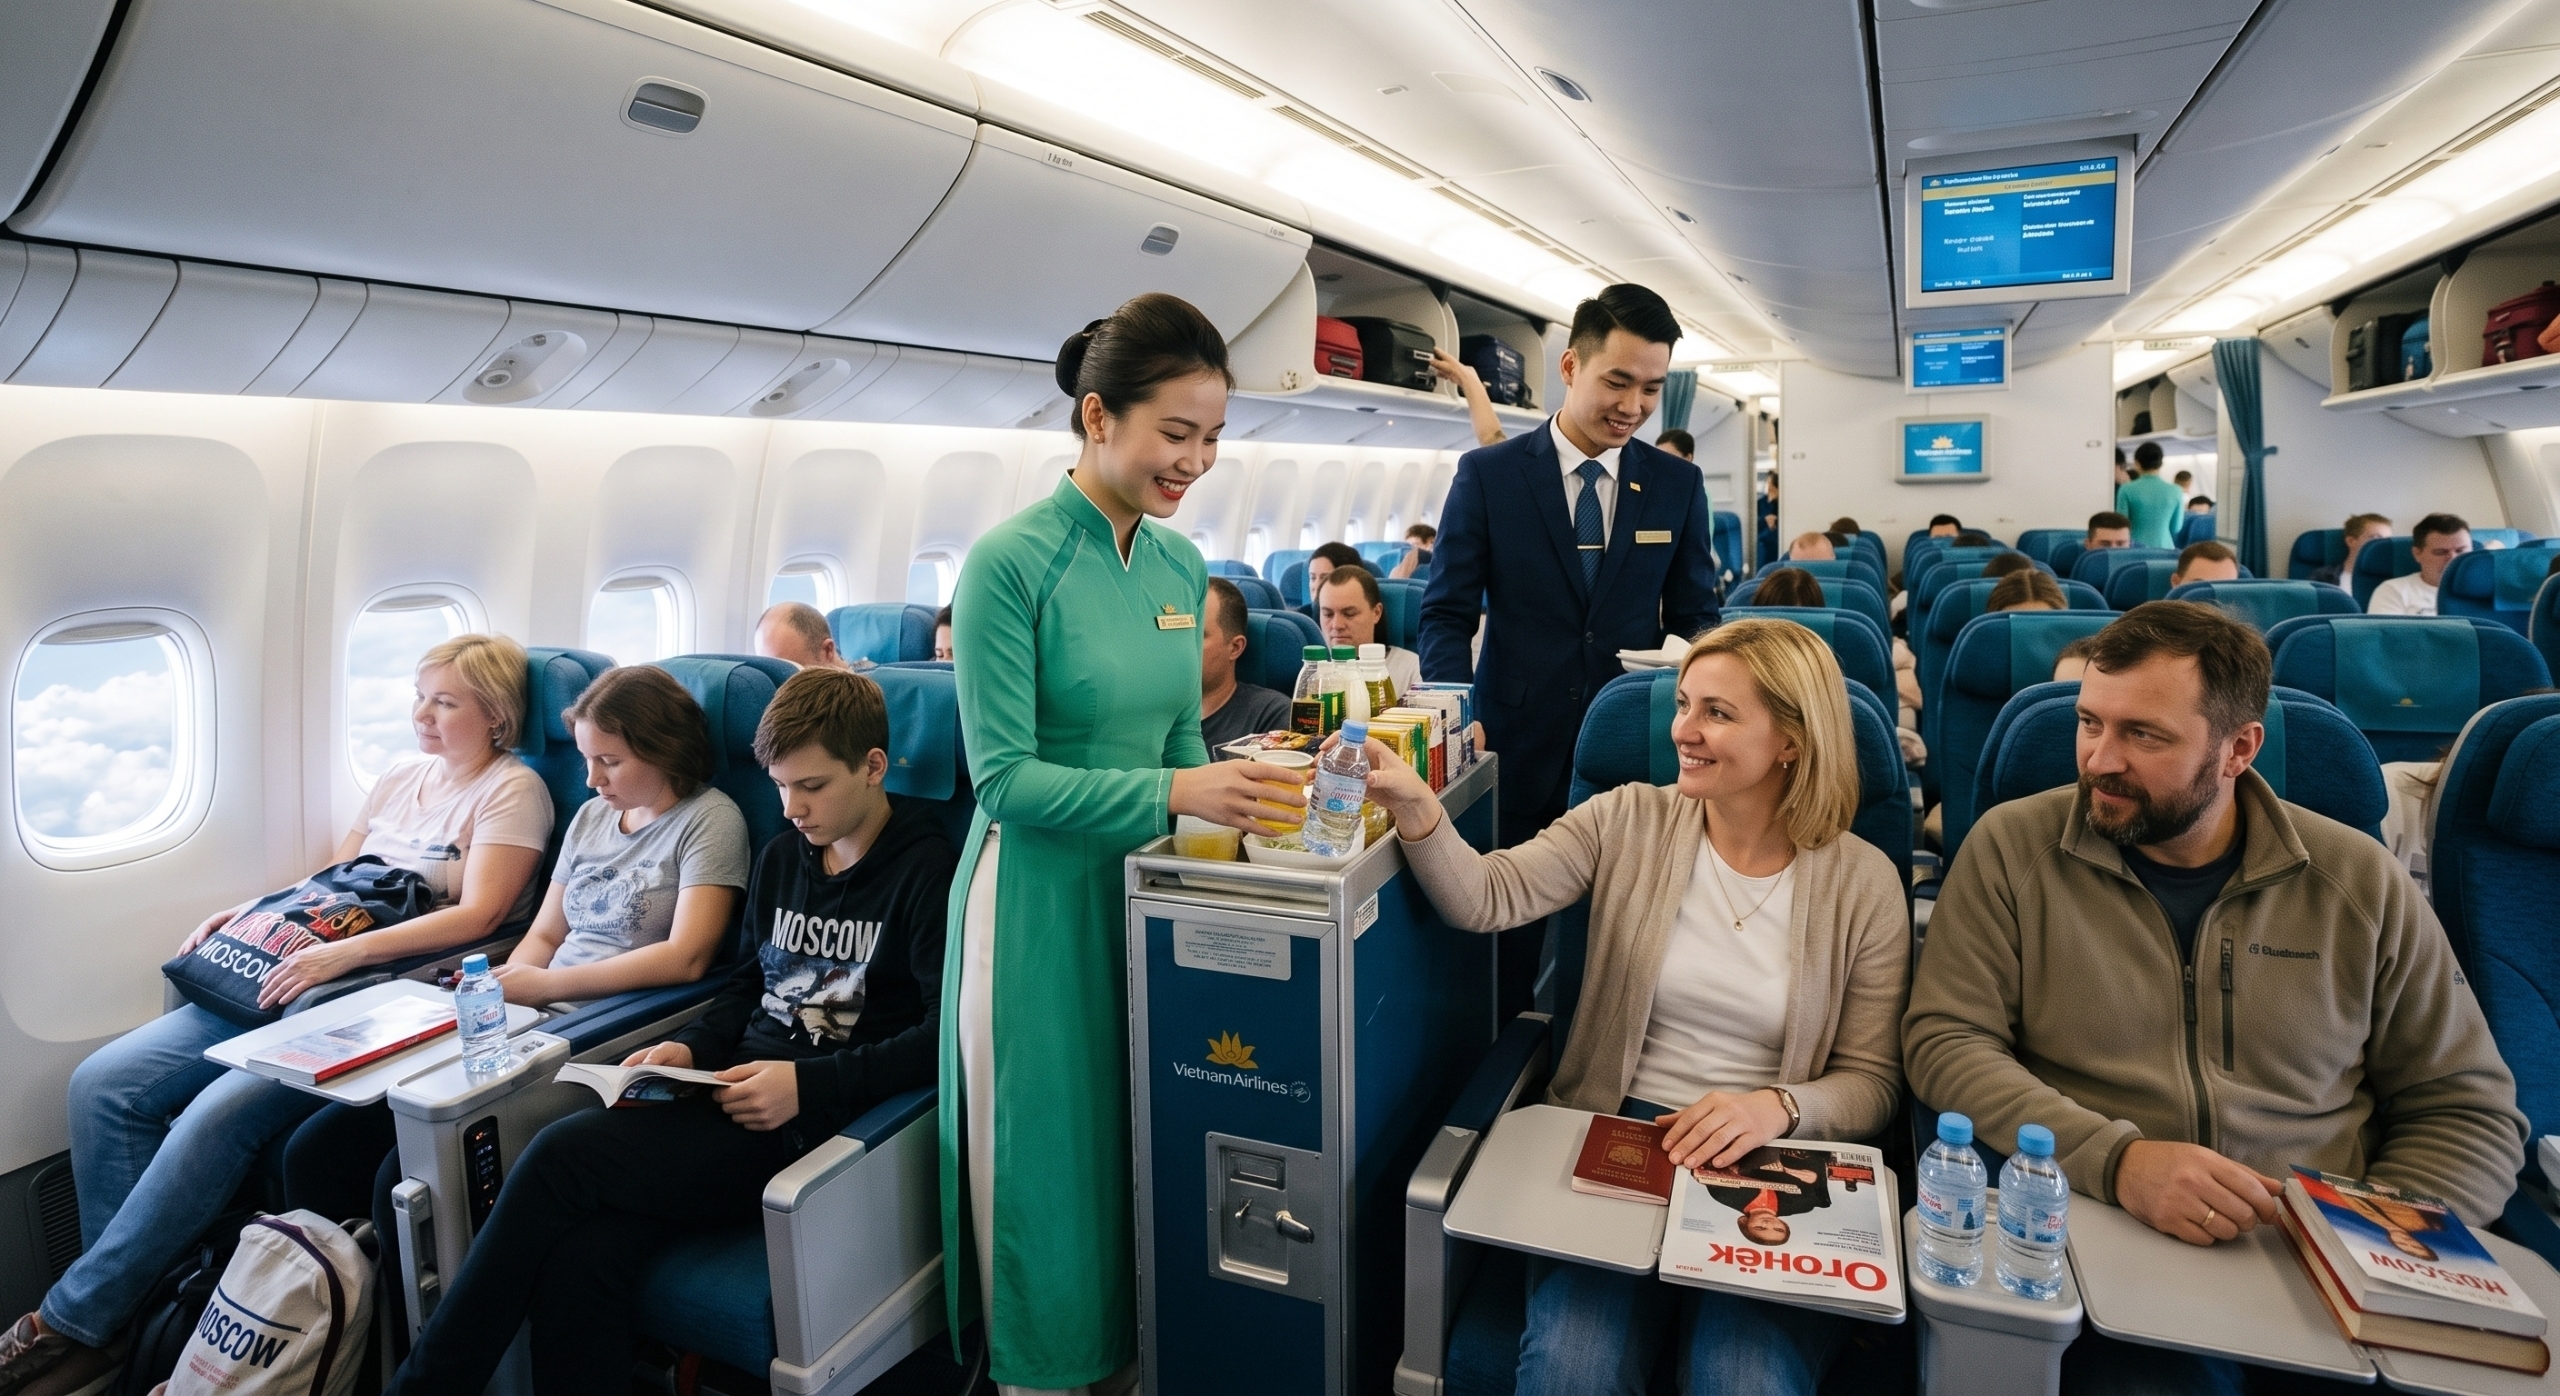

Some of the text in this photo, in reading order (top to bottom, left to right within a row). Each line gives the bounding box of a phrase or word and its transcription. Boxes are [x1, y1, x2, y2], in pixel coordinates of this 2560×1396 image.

[771, 907, 882, 963] MOSCOW
[1173, 1062, 1288, 1095] Vietnam Airlines
[1707, 1242, 1888, 1292] Огонёк
